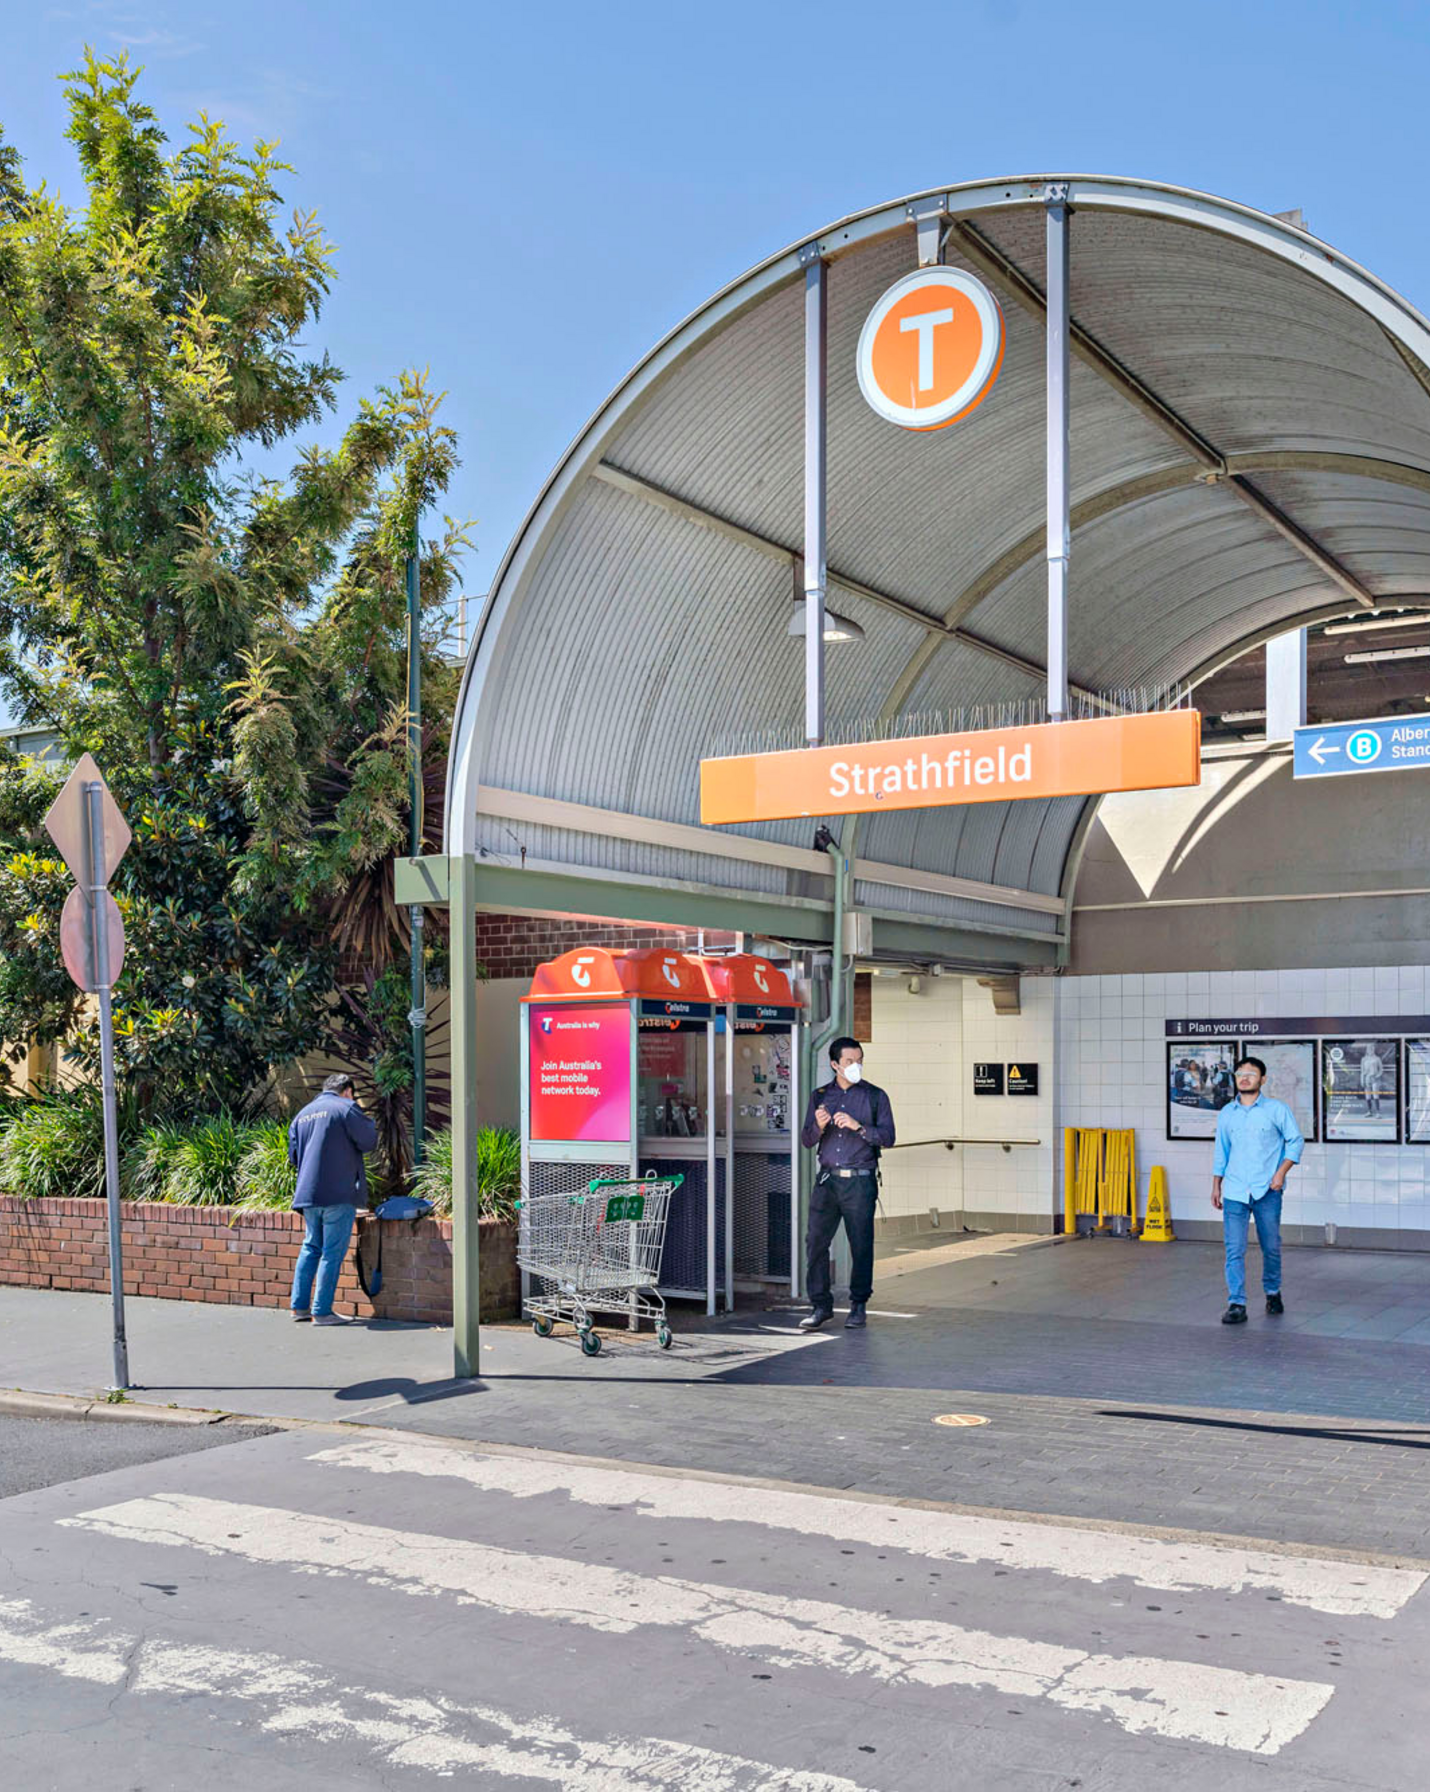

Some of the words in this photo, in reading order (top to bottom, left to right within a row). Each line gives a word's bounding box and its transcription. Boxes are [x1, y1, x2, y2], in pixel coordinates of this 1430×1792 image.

[900, 307, 953, 392] T
[1357, 737, 1372, 757] B
[829, 743, 1031, 797] Strathfield
[588, 1022, 601, 1030] why
[1188, 1022, 1212, 1033] Plan
[1213, 1023, 1237, 1034] your
[1239, 1022, 1259, 1034] trip
[541, 1061, 557, 1070] Join
[559, 1060, 602, 1070] Australia's
[541, 1073, 559, 1082] best
[561, 1072, 588, 1082] mobile
[541, 1085, 574, 1095] network
[575, 1085, 601, 1097] today.
